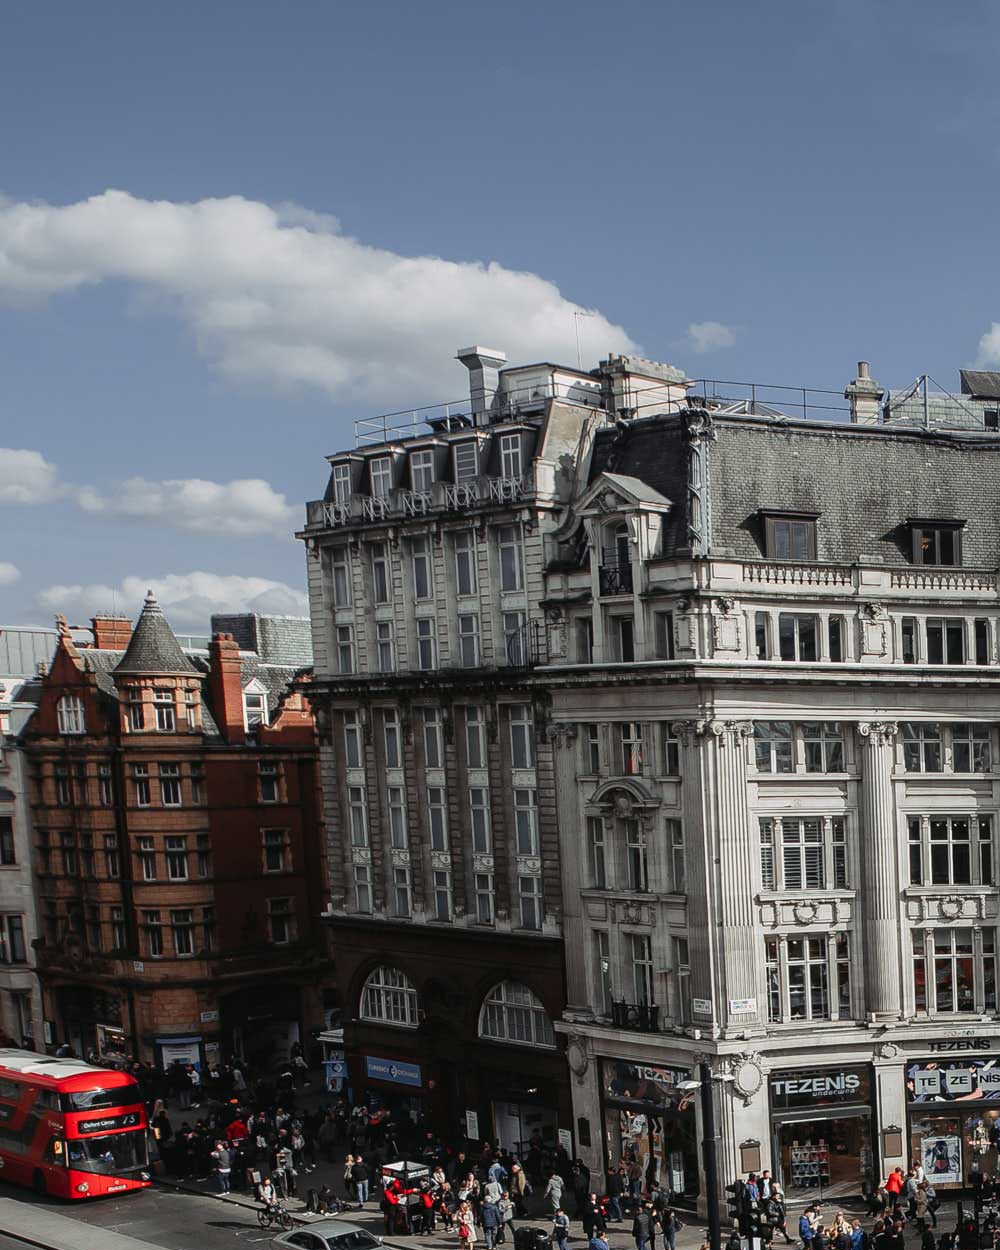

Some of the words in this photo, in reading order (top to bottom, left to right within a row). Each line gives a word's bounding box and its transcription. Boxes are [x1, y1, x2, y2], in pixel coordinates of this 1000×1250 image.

[928, 1039, 991, 1051] TEZENIS
[771, 1073, 860, 1095] TEZENIS
[919, 1077, 937, 1087] TE
[950, 1075, 968, 1085] ZE
[979, 1072, 1000, 1083] NIS
